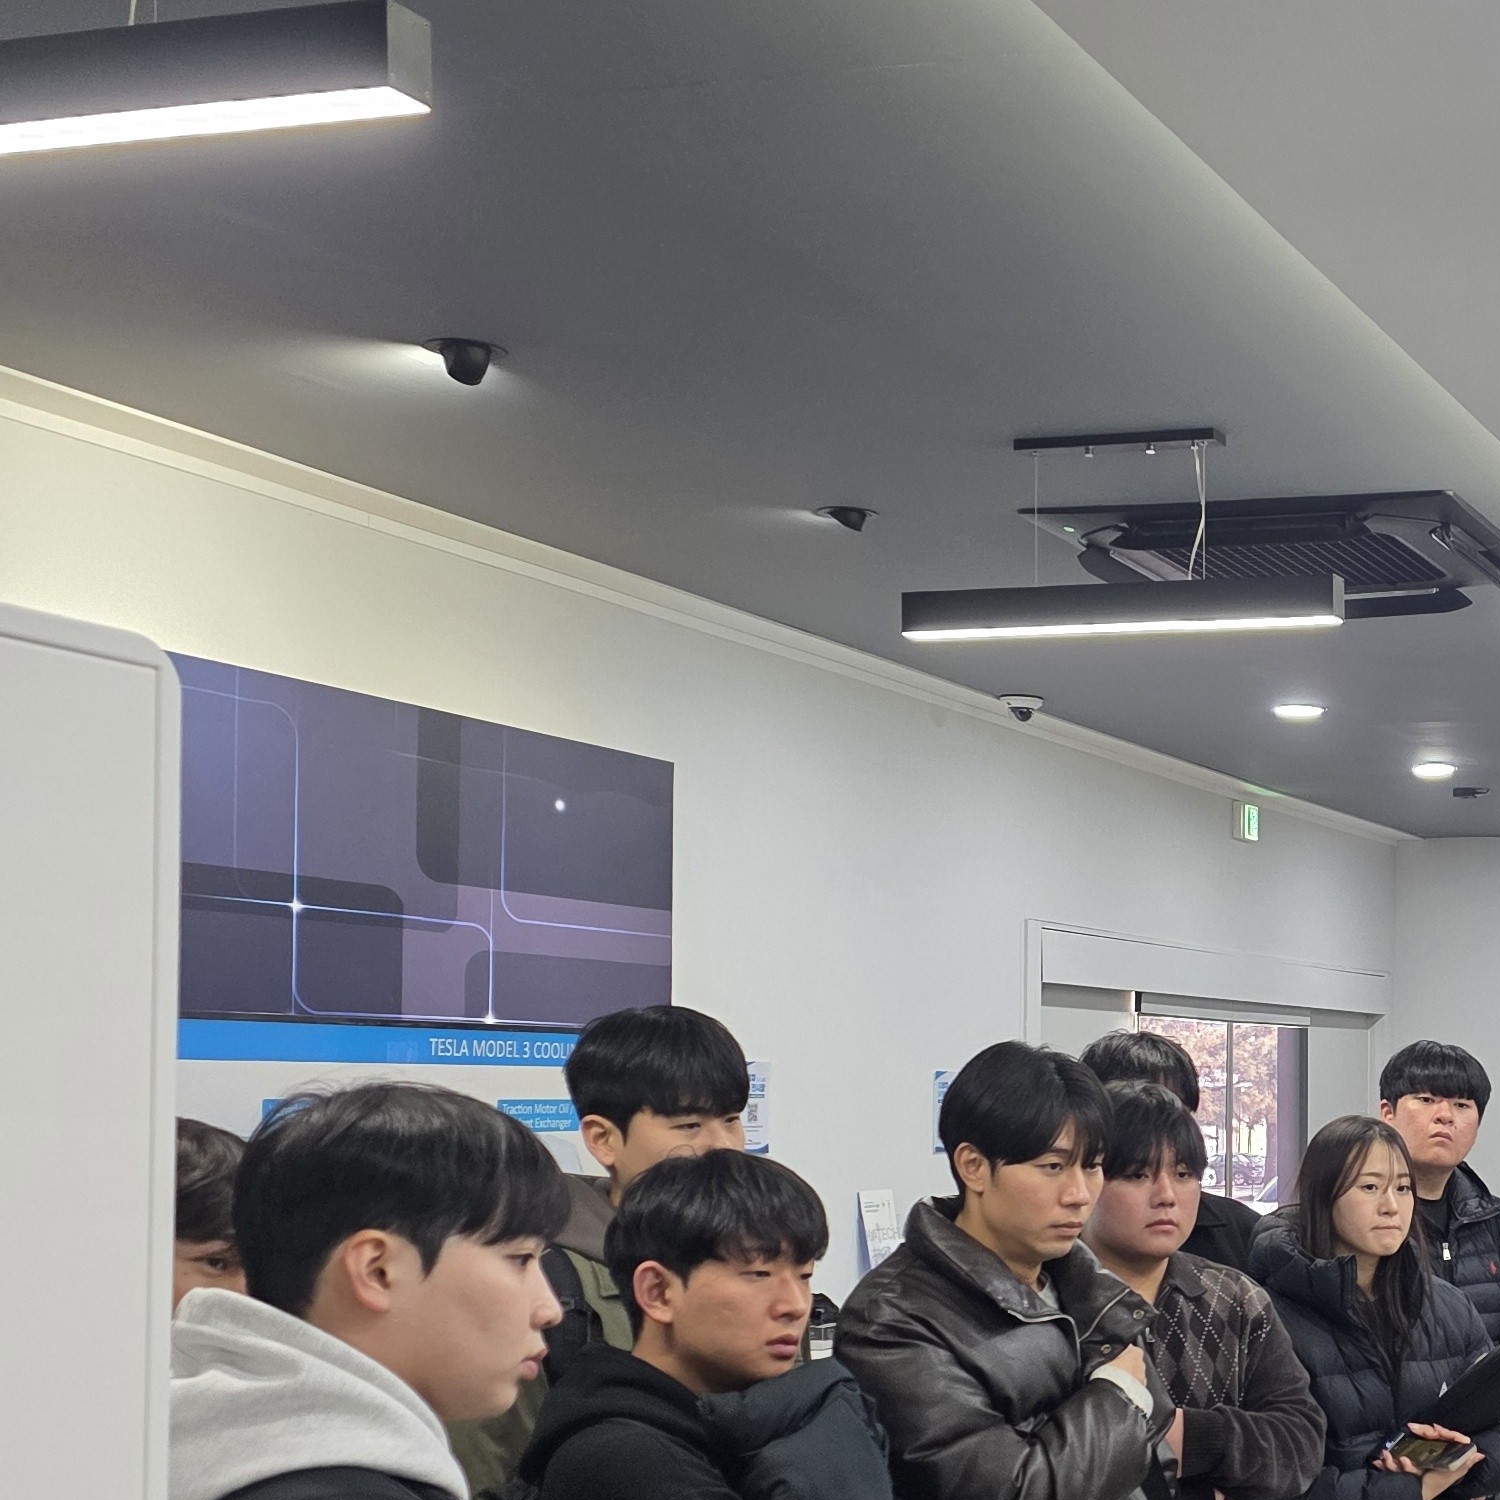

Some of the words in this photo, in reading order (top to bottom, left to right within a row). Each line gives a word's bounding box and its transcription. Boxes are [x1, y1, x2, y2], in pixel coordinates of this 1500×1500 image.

[429, 1037, 469, 1057] TESLA
[472, 1039, 520, 1058] MODEL
[522, 1041, 530, 1059] 3
[502, 1103, 533, 1115] Traction
[534, 1103, 558, 1114] Motor
[534, 1117, 572, 1130] Exchanger
